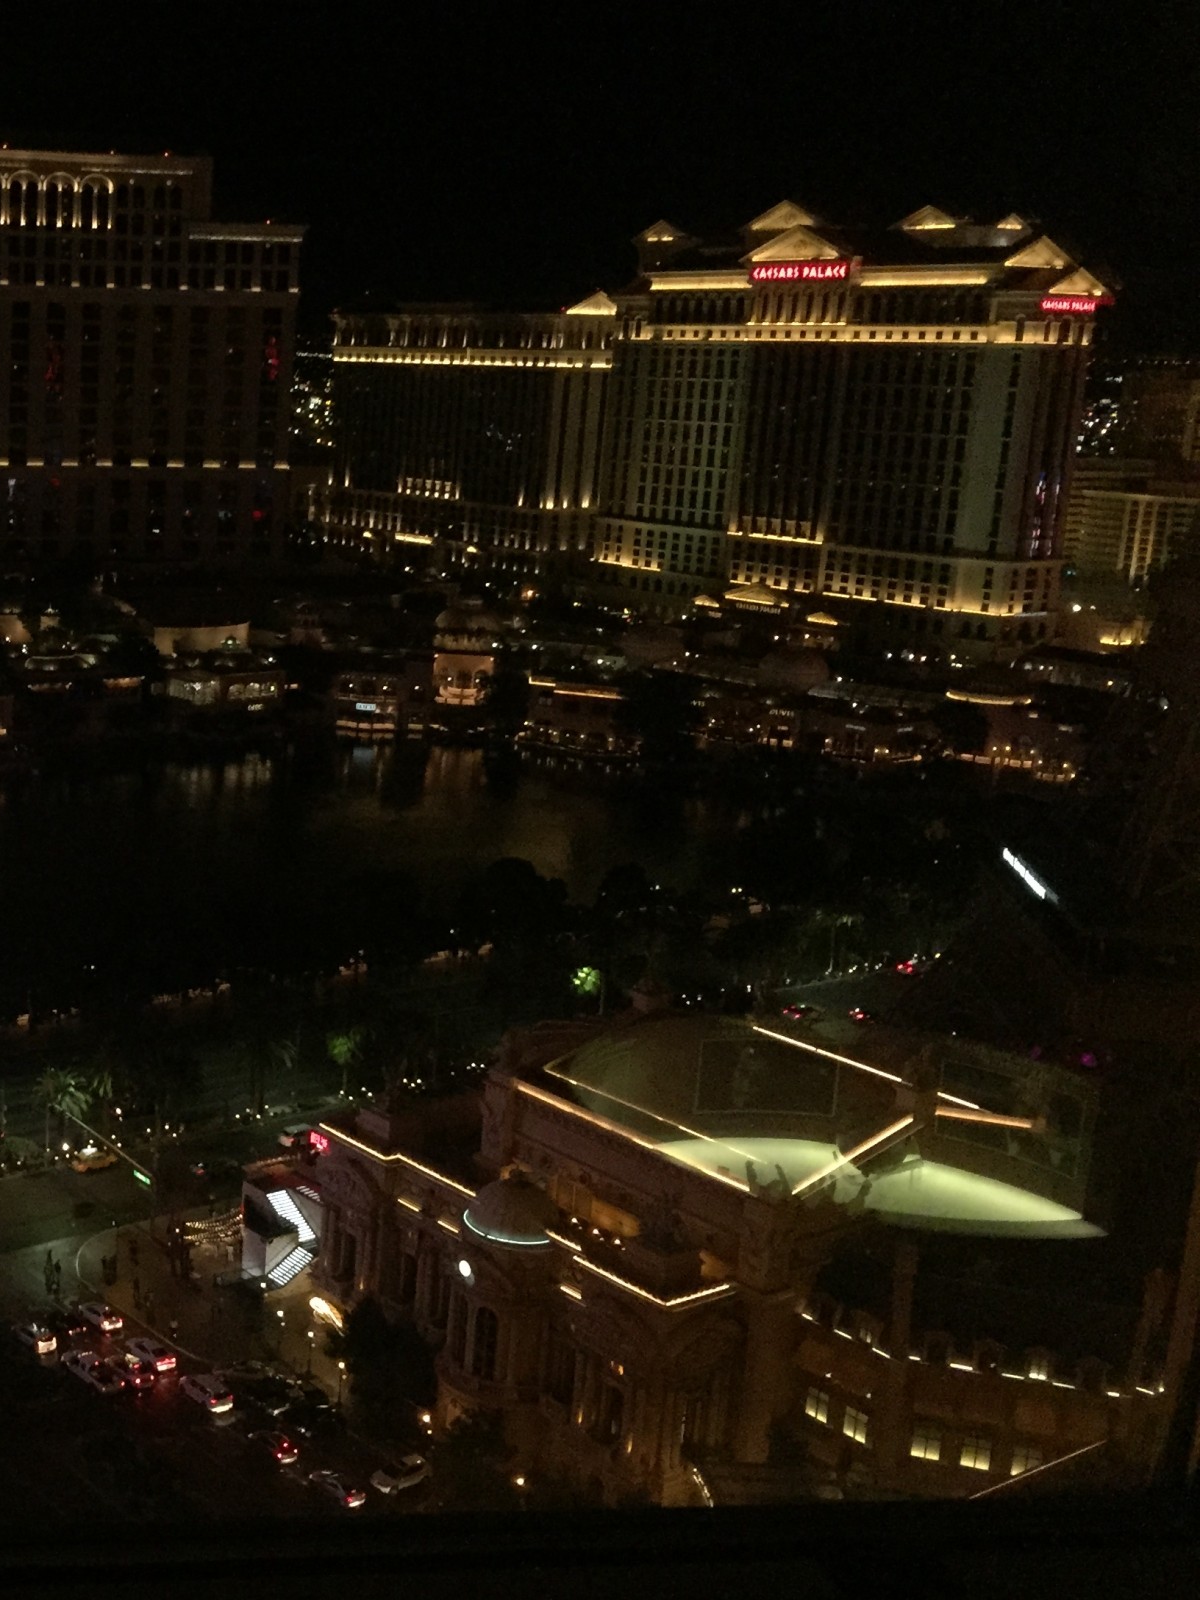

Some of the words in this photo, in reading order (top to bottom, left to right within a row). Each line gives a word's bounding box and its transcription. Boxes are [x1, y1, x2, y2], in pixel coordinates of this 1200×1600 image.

[753, 266, 800, 280] CAESARS
[803, 265, 846, 280] PALACE
[1042, 300, 1070, 310] CAESARS
[1071, 301, 1096, 311] PALACE
